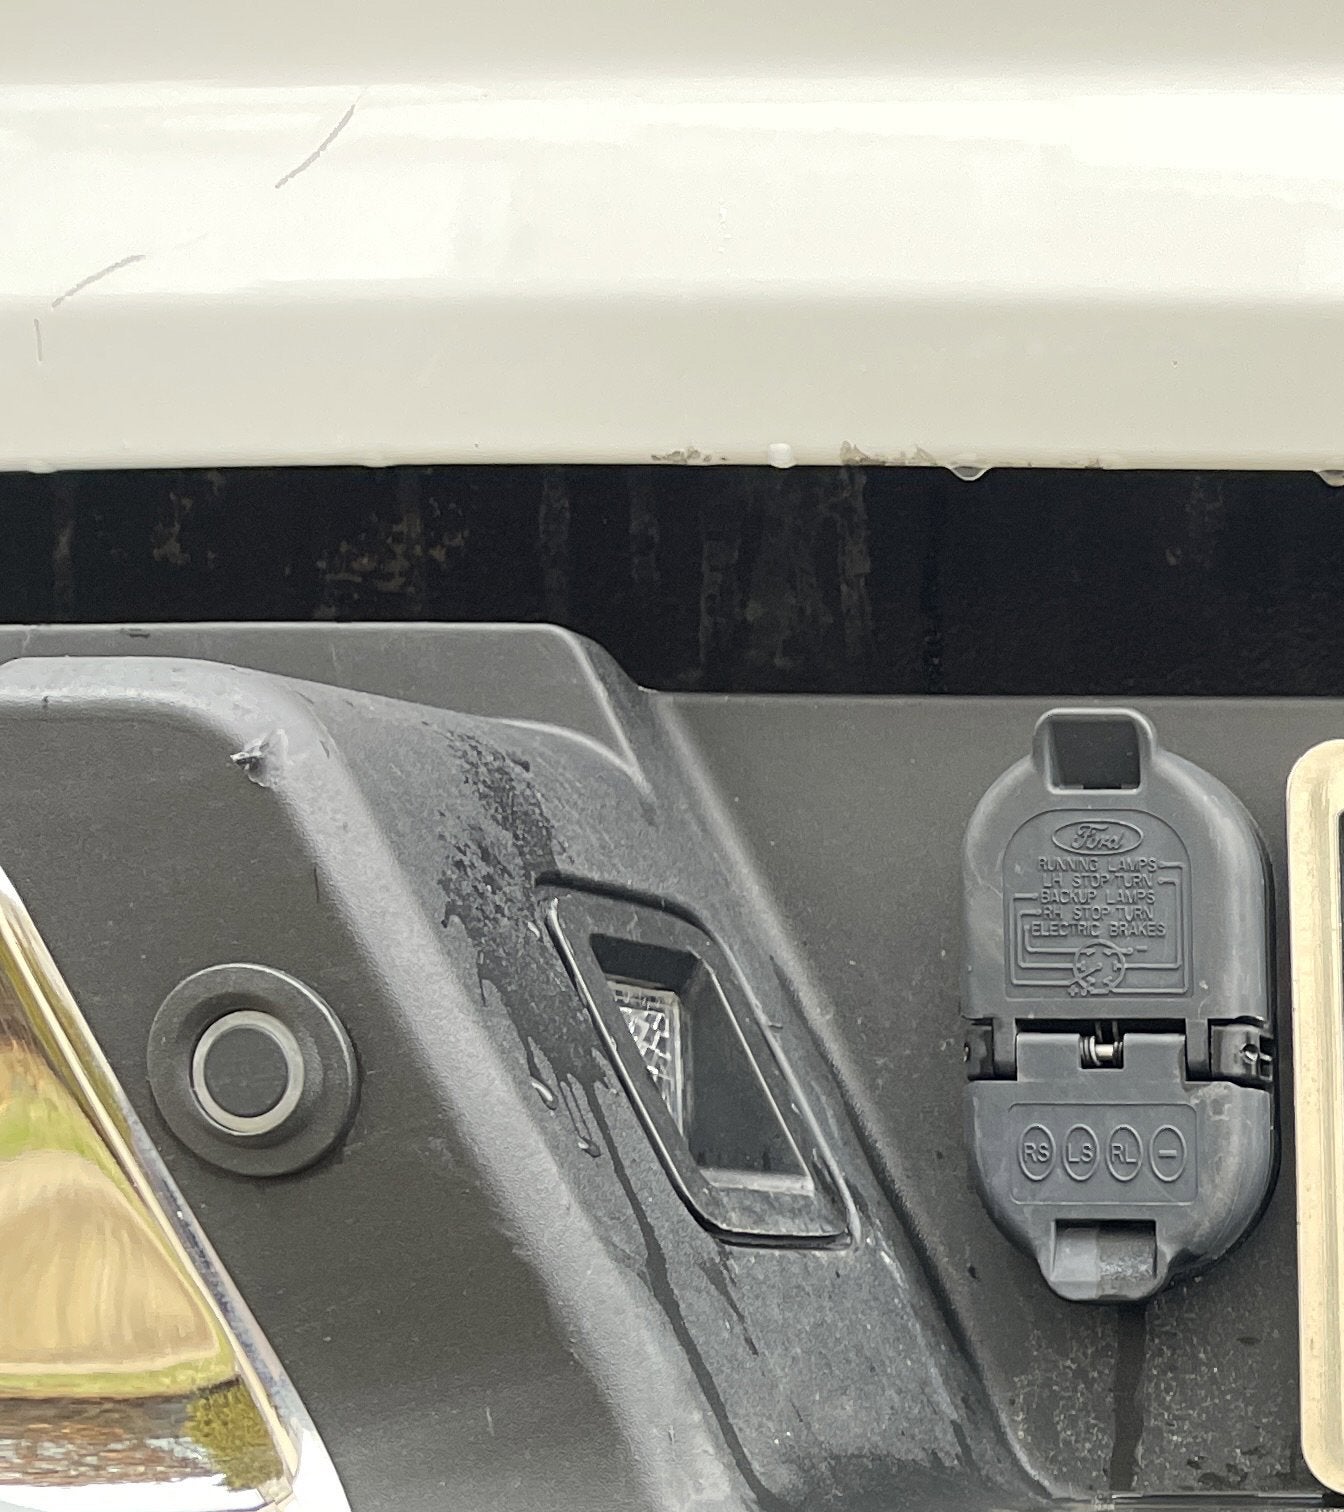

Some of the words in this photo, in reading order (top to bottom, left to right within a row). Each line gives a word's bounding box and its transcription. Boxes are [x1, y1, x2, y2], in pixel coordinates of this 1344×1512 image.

[1071, 823, 1125, 849] Ford
[1038, 856, 1098, 872] RUNNING
[1108, 856, 1157, 873] LAMPS
[1042, 872, 1063, 888] LH
[1041, 888, 1097, 904] BACKUP
[1106, 888, 1155, 905] LAMPS
[1043, 904, 1062, 920] RH
[1031, 920, 1100, 937] ELECTRIC
[1109, 920, 1166, 937] BRAKES
[1023, 1142, 1050, 1163] RS
[1068, 1142, 1093, 1163] LS
[1111, 1142, 1137, 1164] RL
